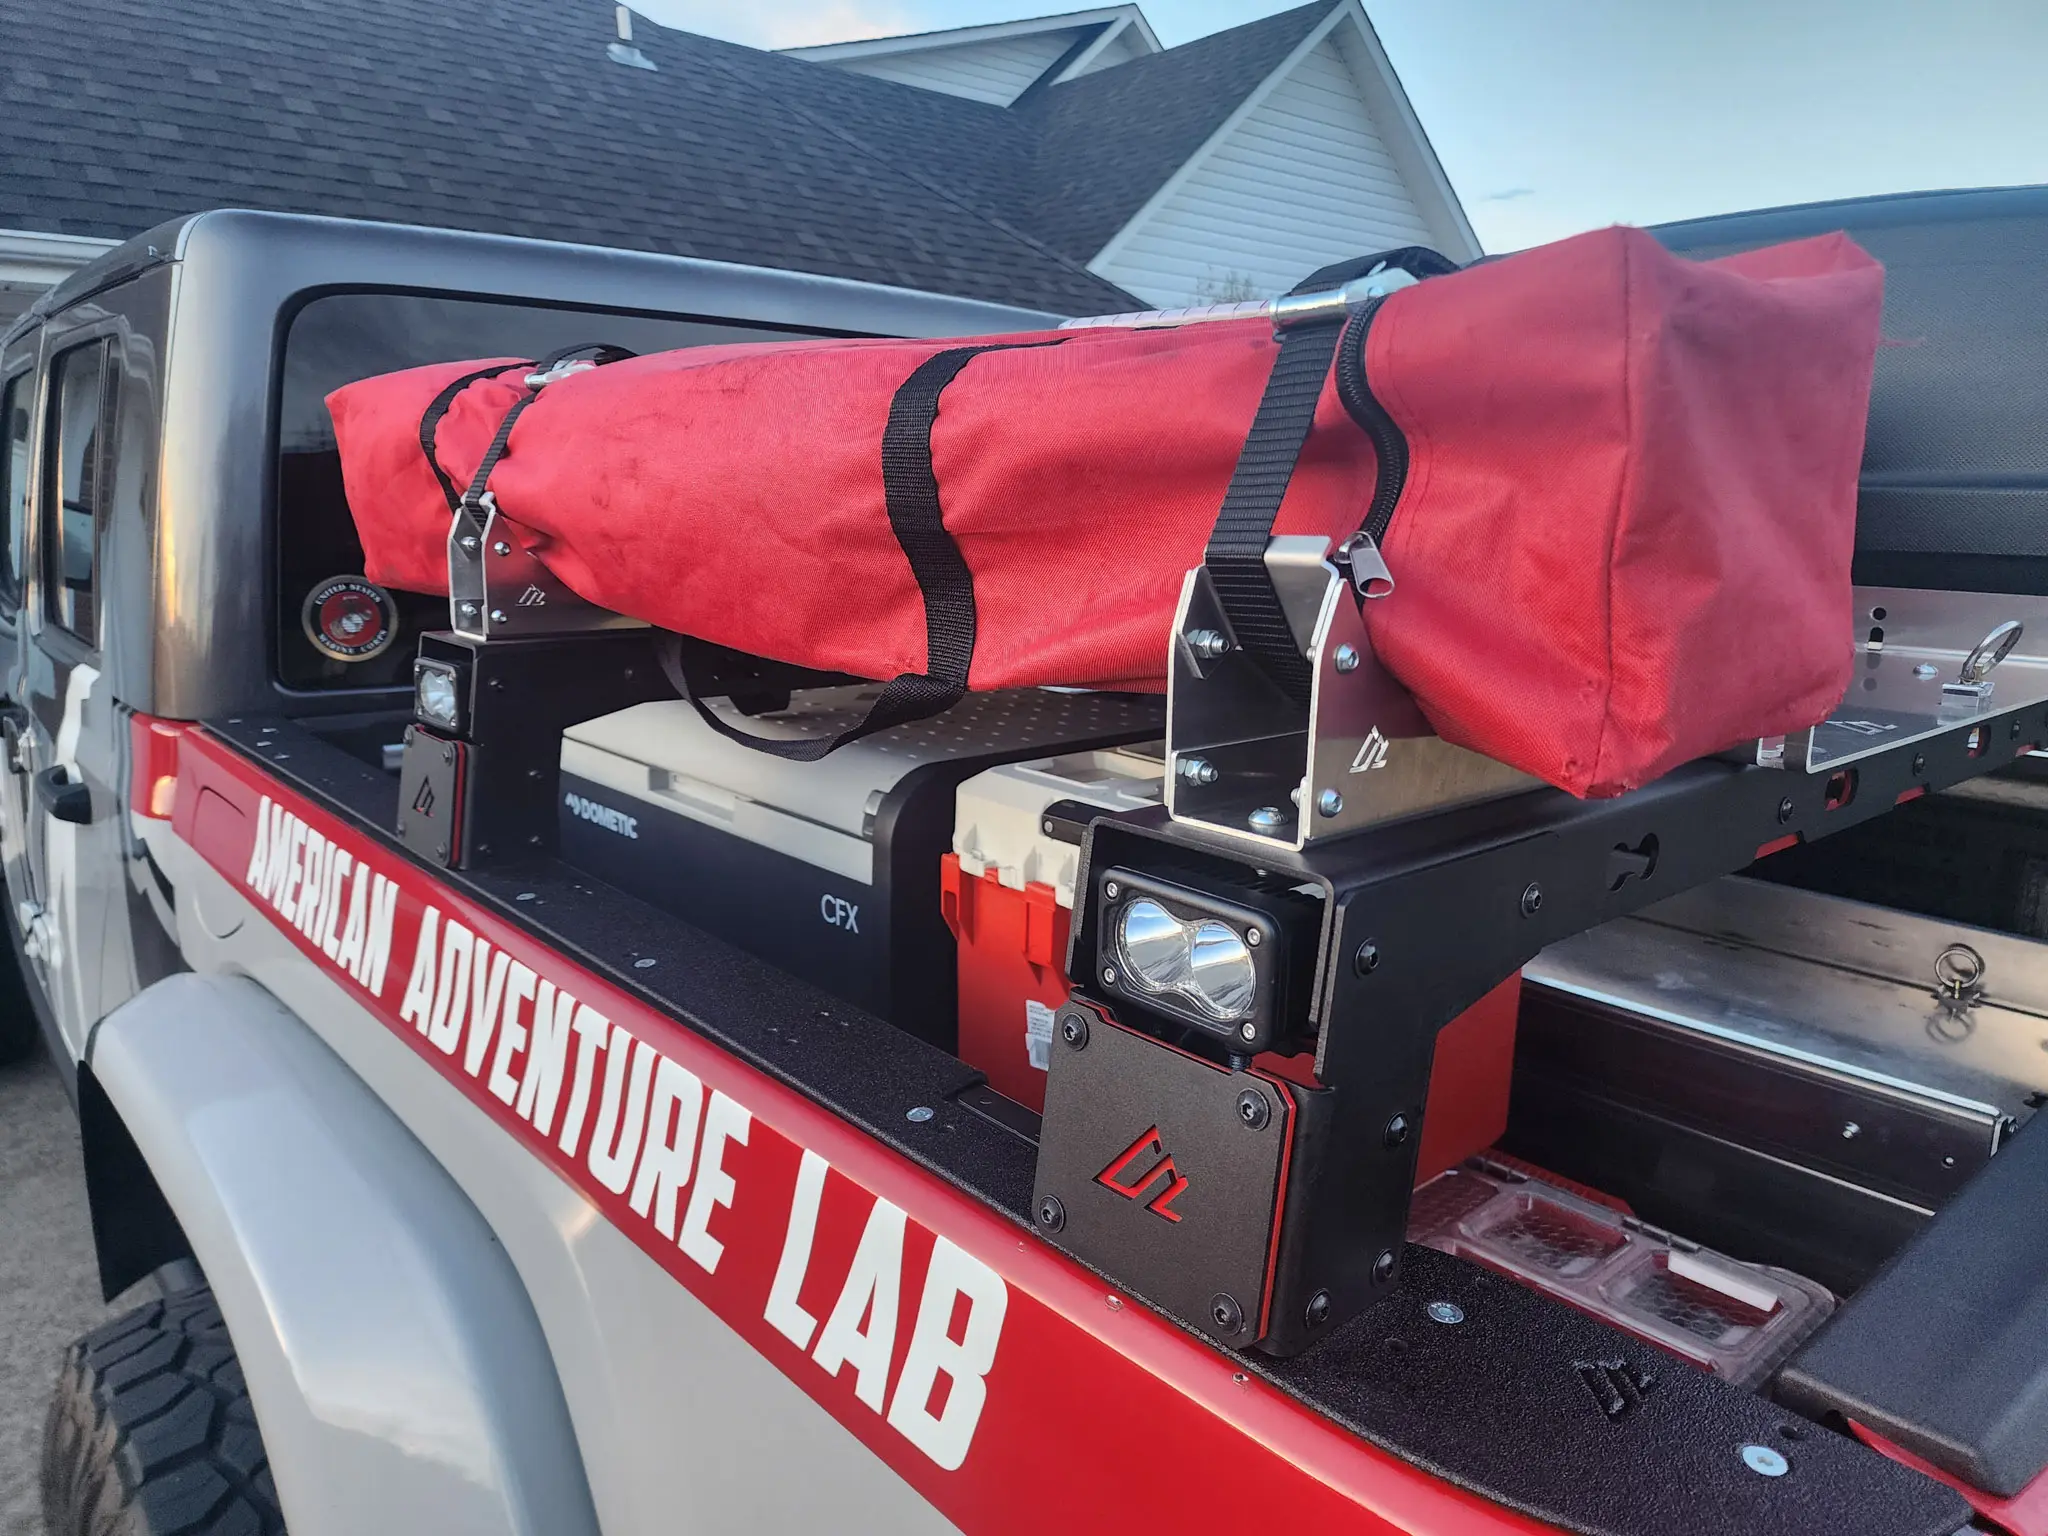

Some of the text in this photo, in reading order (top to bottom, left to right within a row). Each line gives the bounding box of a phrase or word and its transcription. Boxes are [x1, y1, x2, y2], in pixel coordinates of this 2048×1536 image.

[314, 584, 381, 605] UNITED STATES
[580, 797, 639, 839] DOMETIC
[821, 893, 859, 934] CFX
[246, 796, 1009, 1471] AMERICAN ADVENTURE LAB
